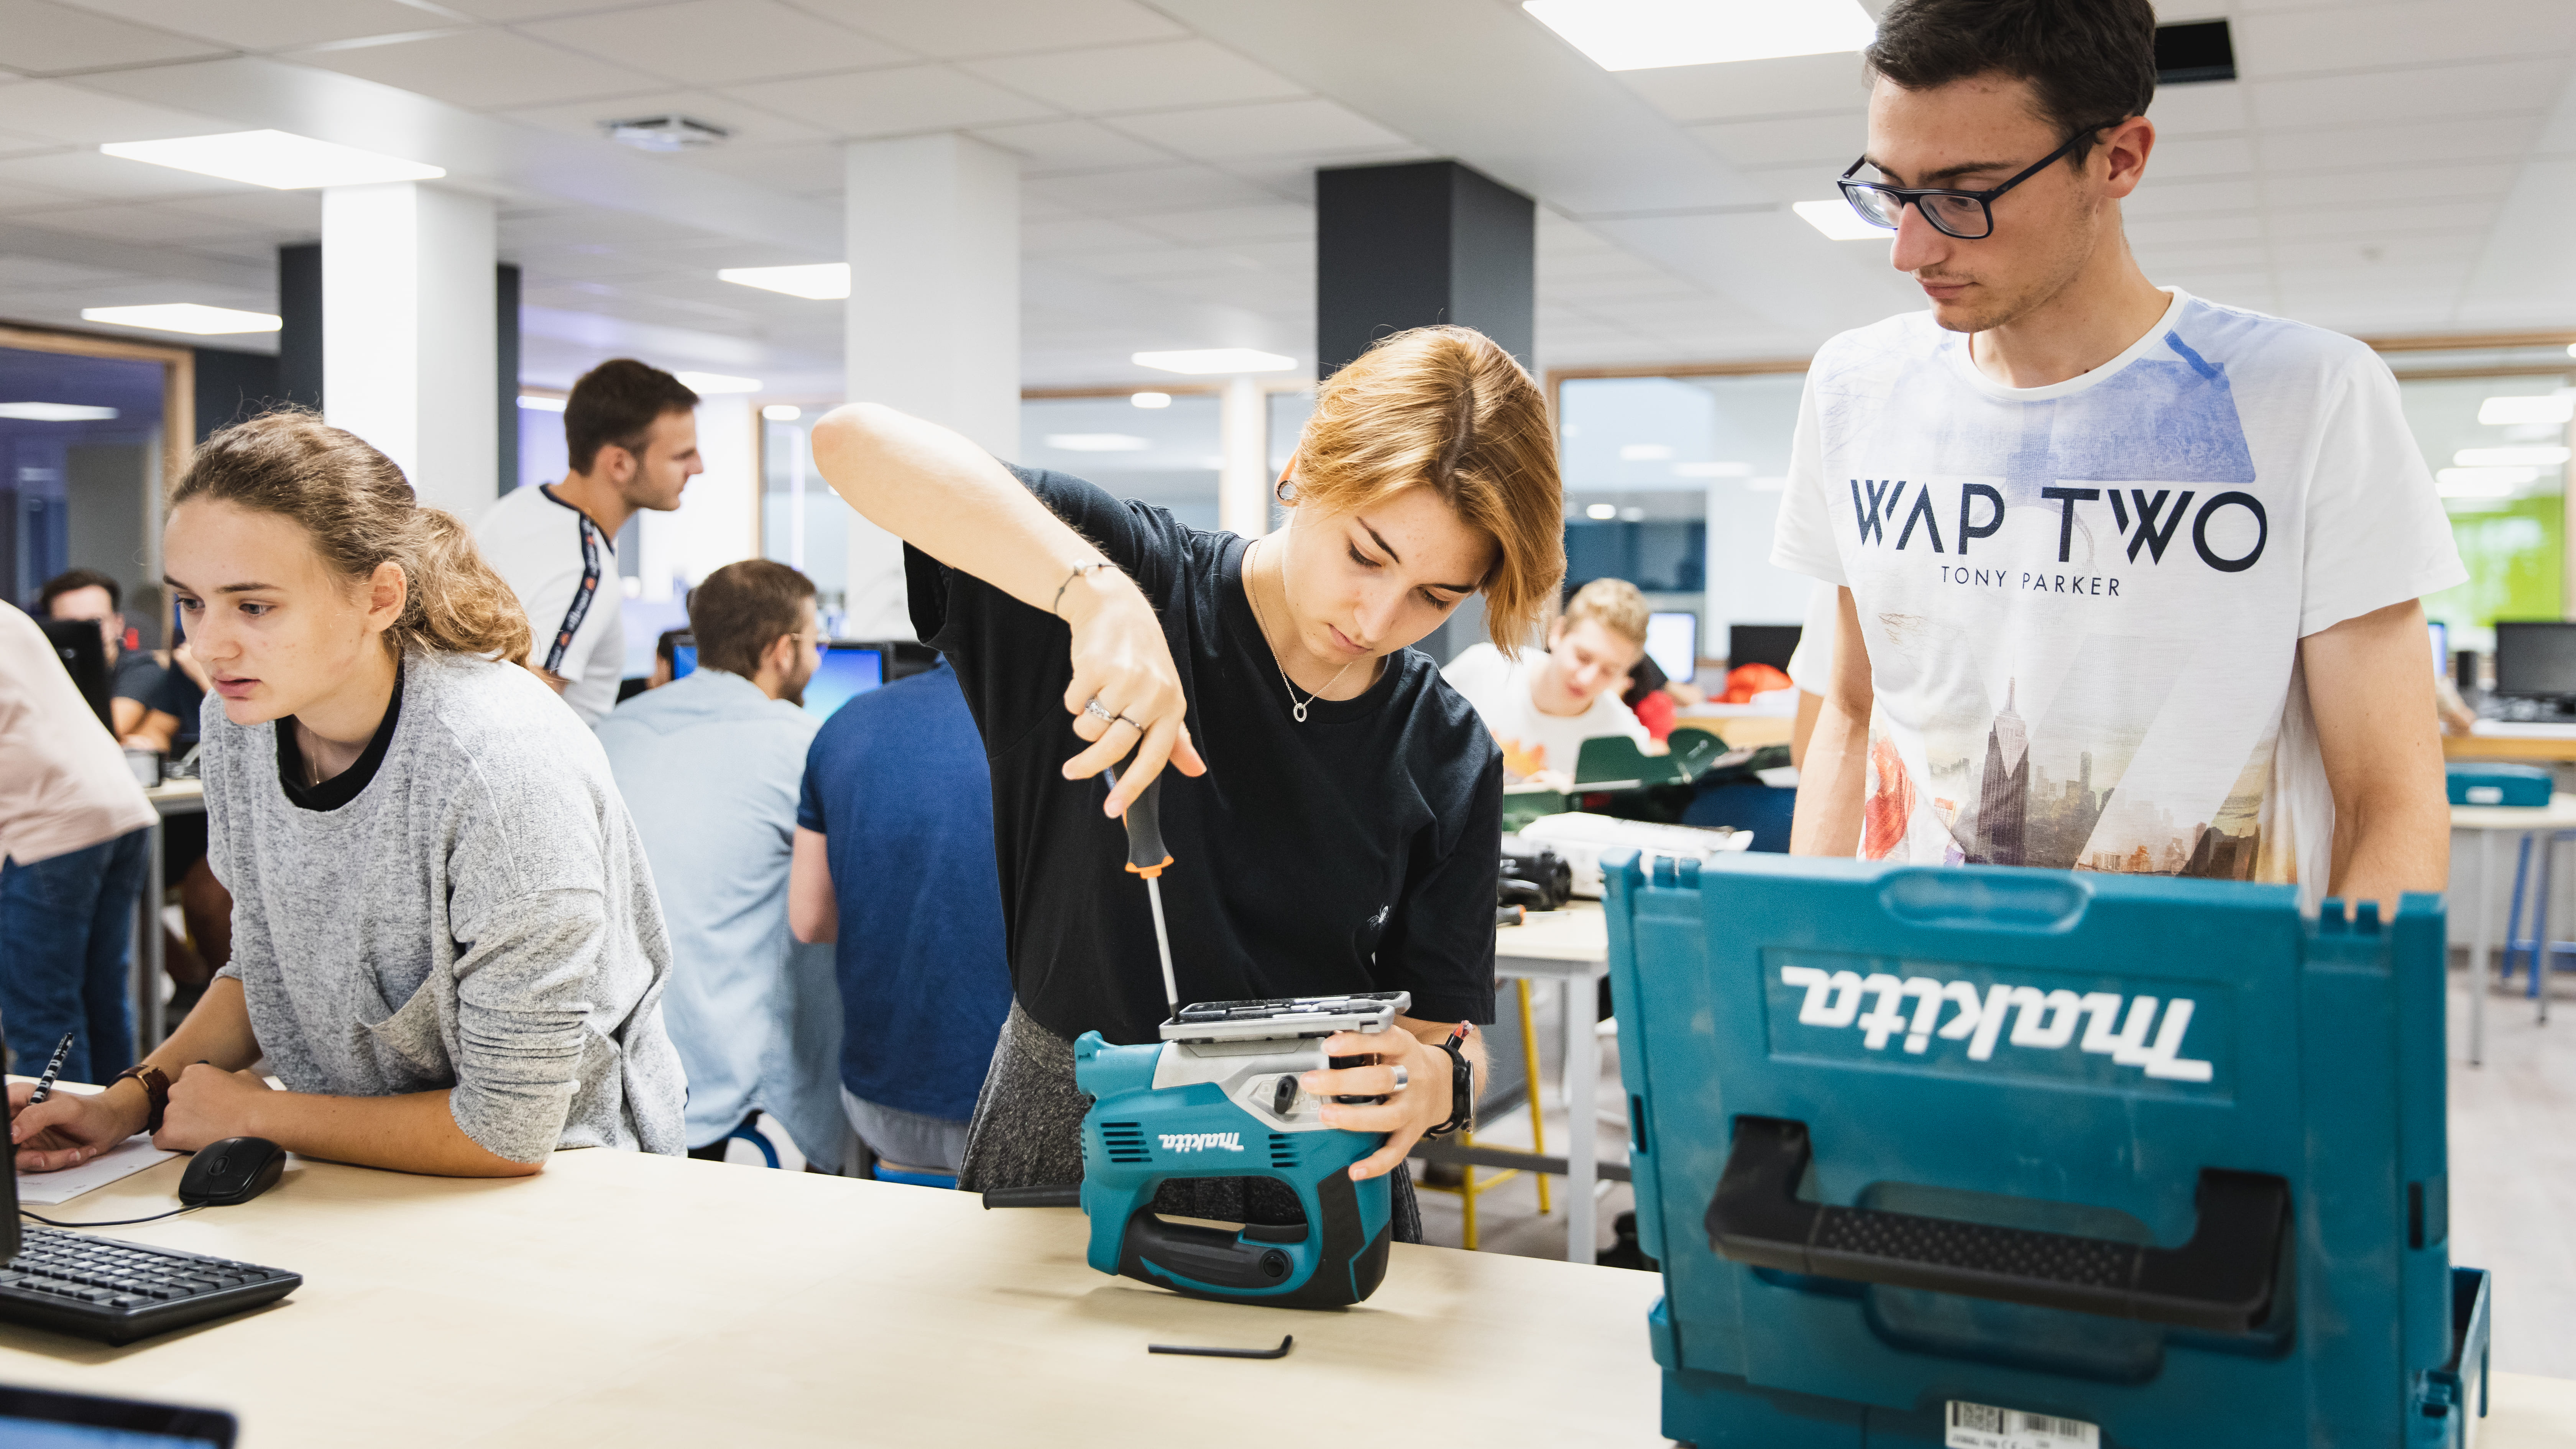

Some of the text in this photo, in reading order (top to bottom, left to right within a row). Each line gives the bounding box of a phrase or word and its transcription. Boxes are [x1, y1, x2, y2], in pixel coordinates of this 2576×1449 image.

[1850, 480, 2267, 573] WAP TWO
[1941, 565, 2119, 596] TONY PARKER
